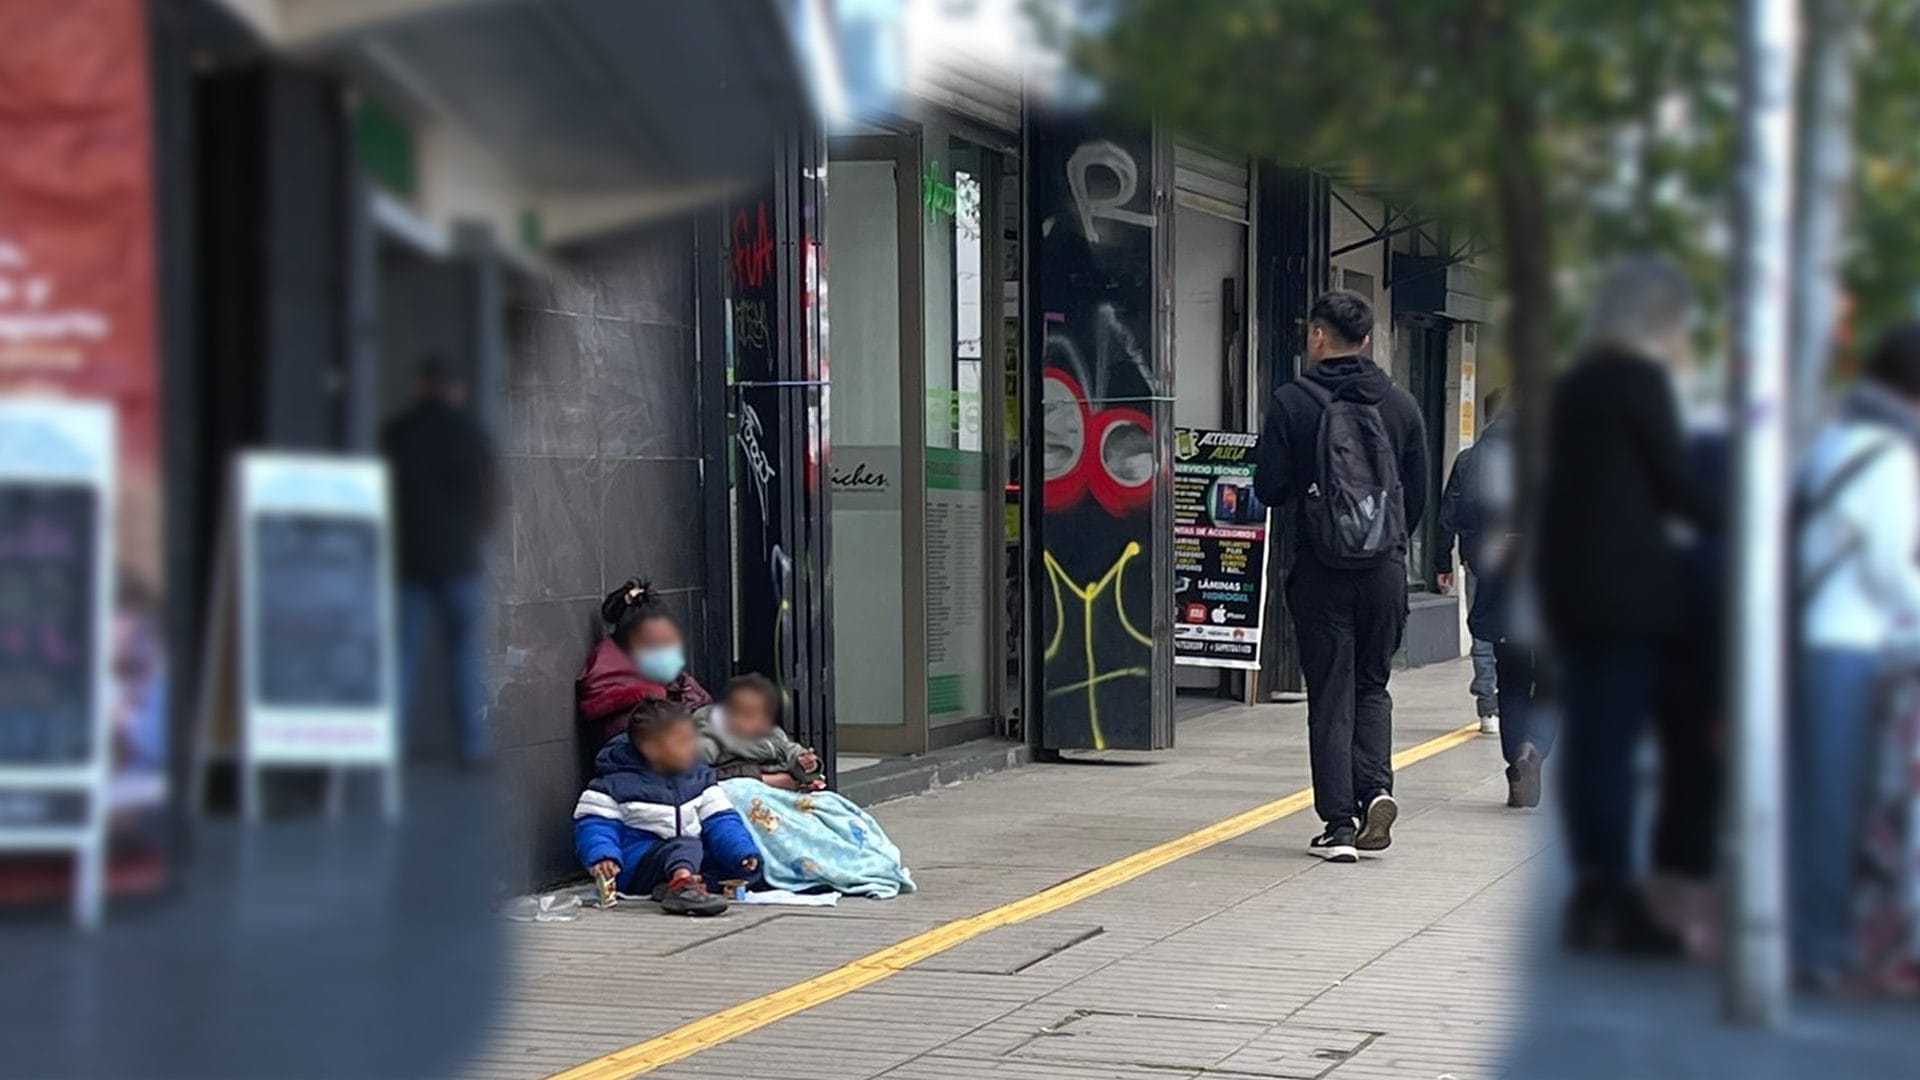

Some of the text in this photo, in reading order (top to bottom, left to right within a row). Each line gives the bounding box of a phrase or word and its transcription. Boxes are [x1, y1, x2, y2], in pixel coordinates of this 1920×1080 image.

[831, 463, 888, 487] iches
[1174, 526, 1256, 539] NTAS DE ACCESORIOS
[1198, 577, 1241, 592] LÁMINAS
[1202, 591, 1248, 602] HIDROGEL
